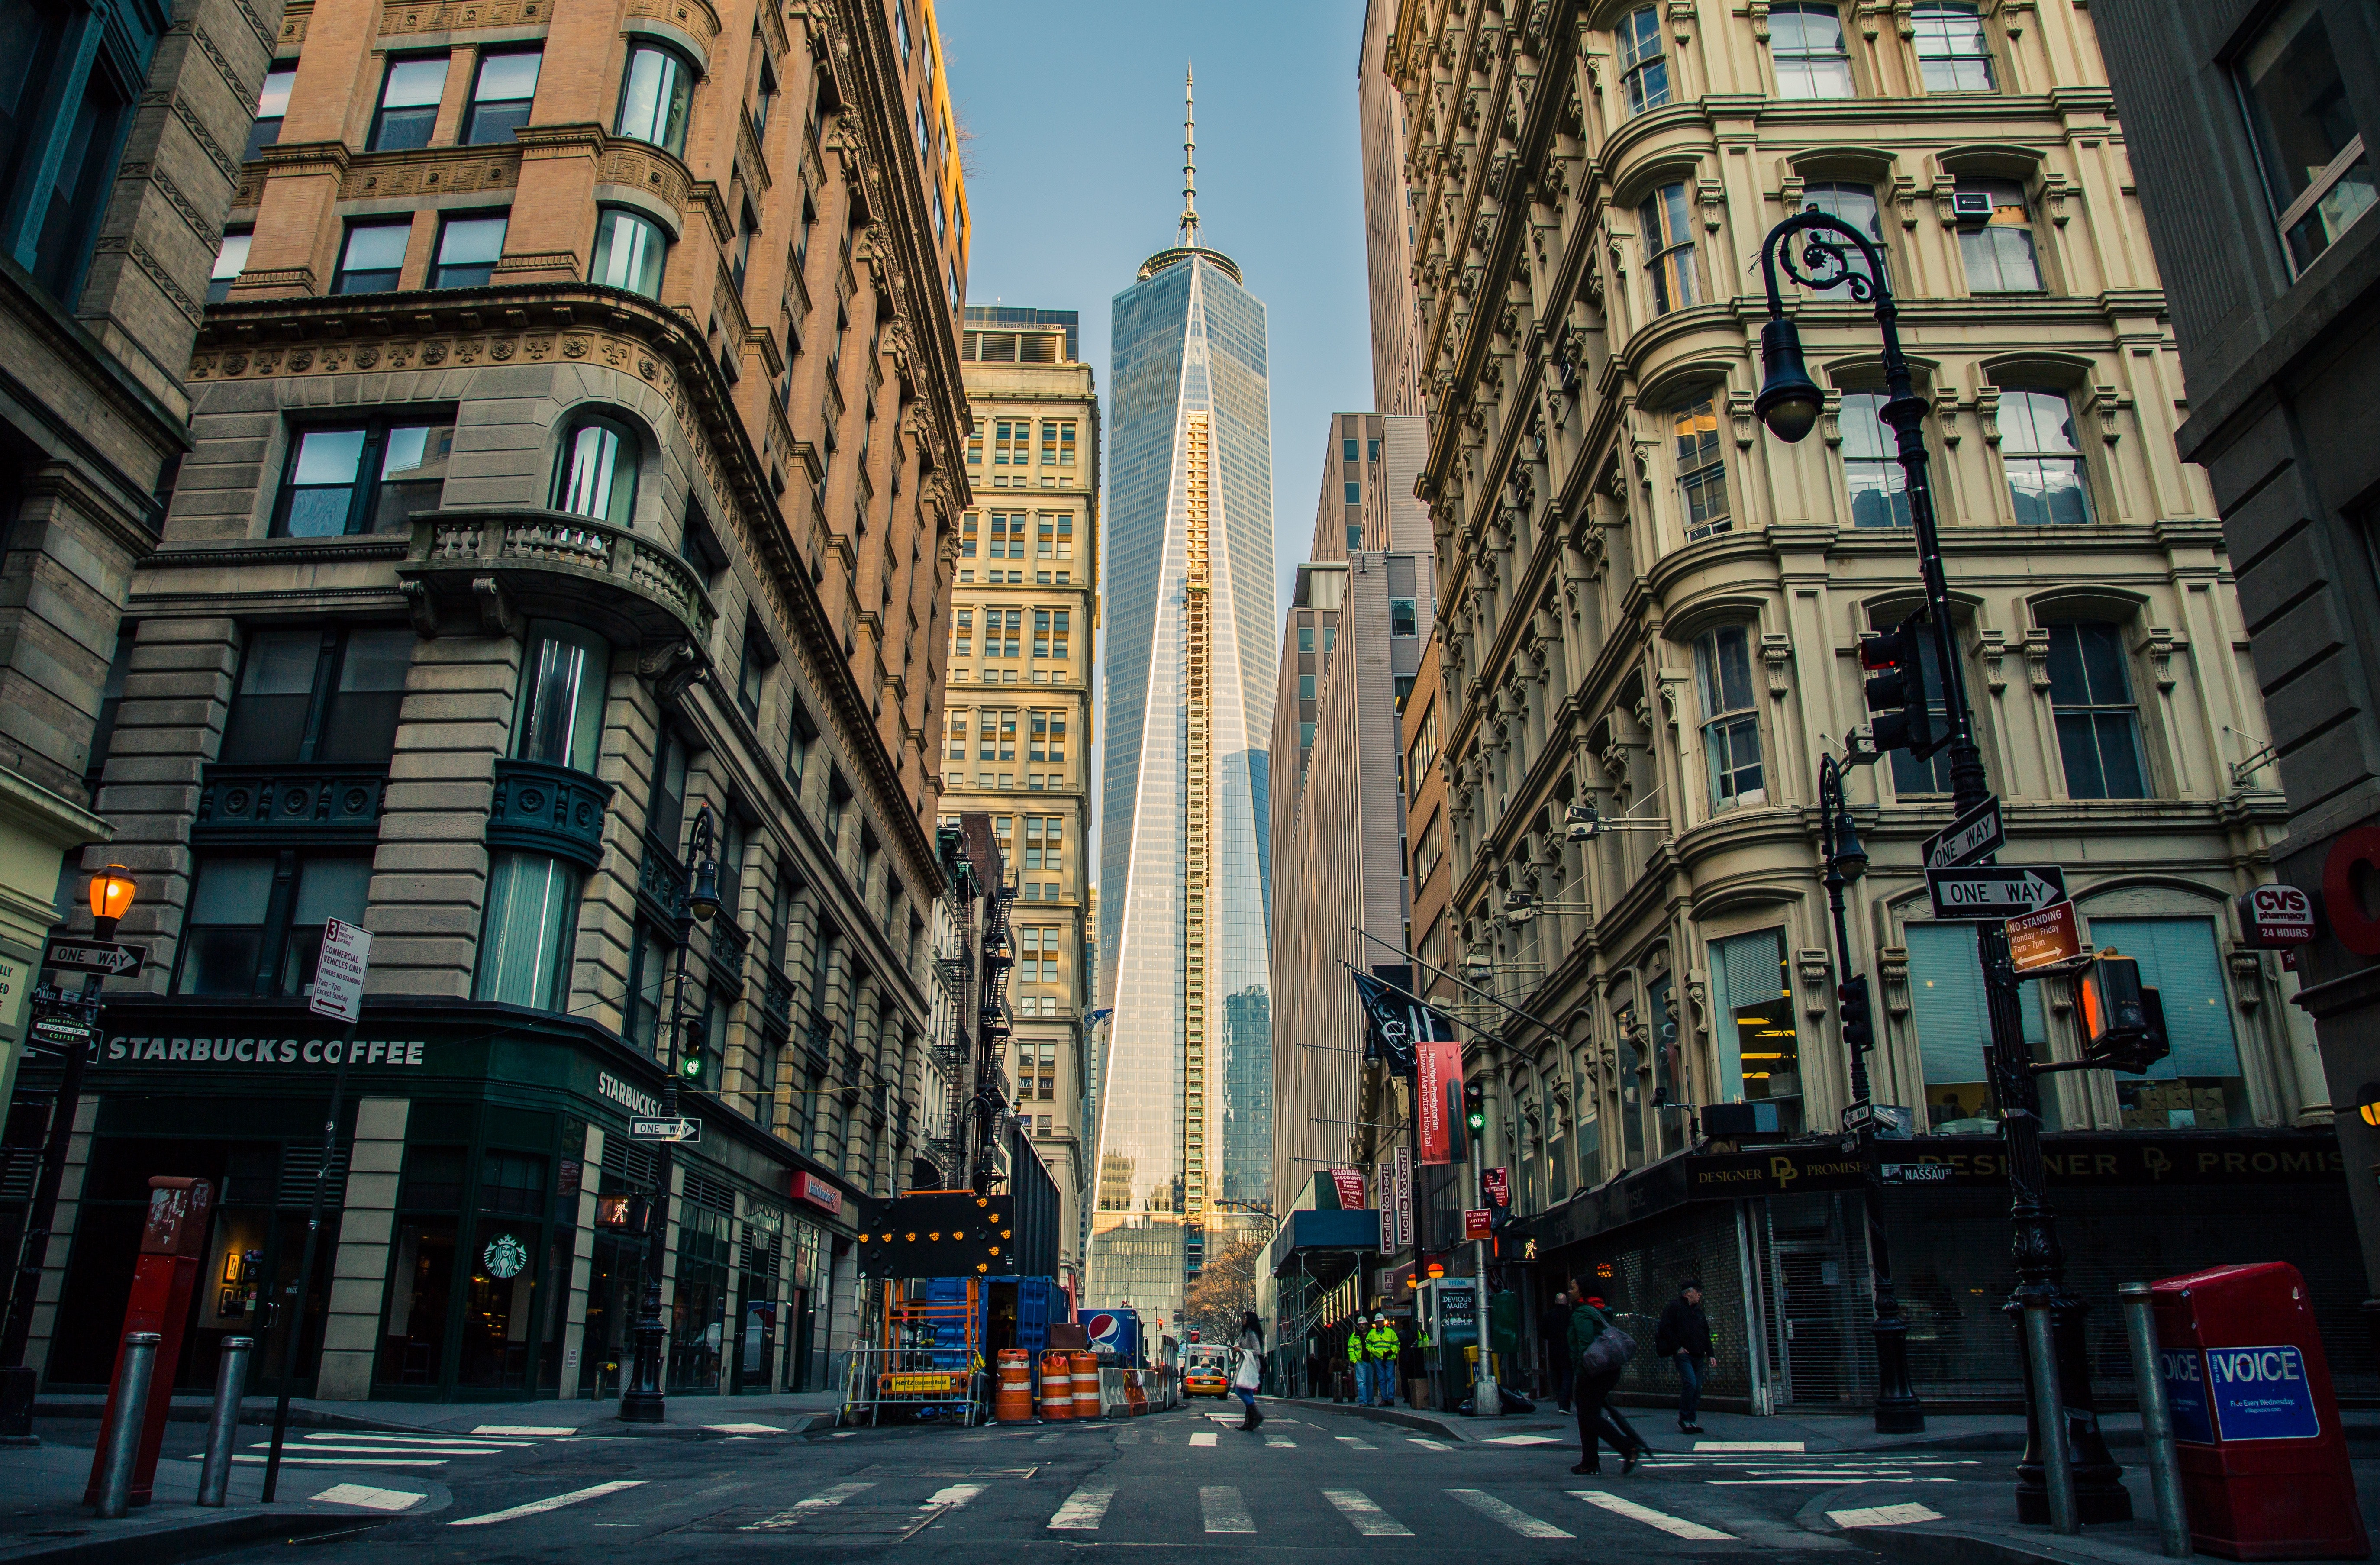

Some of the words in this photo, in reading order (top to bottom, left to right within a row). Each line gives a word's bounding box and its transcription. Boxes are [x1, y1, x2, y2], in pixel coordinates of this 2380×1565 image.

[1935, 840, 1958, 867] ONE
[1966, 817, 1990, 849] WAY
[1950, 884, 1990, 903] ONE
[2004, 882, 2045, 901] WAY
[2255, 891, 2306, 911] CVS
[2009, 922, 2020, 933] NO
[2022, 909, 2062, 929] STANDING
[2258, 911, 2306, 921] pharmacy
[328, 921, 338, 939] 3
[338, 932, 354, 941] metered
[2011, 932, 2035, 944] Monday
[2040, 925, 2059, 936] Friday
[2262, 928, 2274, 937] 24
[2276, 928, 2309, 937] HOURS
[337, 937, 352, 947] parking
[2013, 944, 2027, 953] 7am
[2031, 939, 2045, 949] 7pm
[58, 948, 87, 962] ONE
[98, 952, 129, 966] WAY
[325, 945, 359, 964] COMMERCIAL
[2286, 952, 2294, 963] 24
[324, 955, 348, 970] VEHICLES
[349, 964, 362, 974] ONLY
[319, 978, 328, 987] 7am
[332, 982, 341, 991] 7pm
[320, 967, 336, 978] OTHERS
[342, 974, 361, 986] STANDING
[316, 987, 332, 998] Except
[332, 991, 348, 1004] Sunday
[41, 1024, 85, 1035] FINANCIER
[63, 1019, 84, 1028] ROASTED
[49, 1033, 75, 1041] COFFEE
[108, 1036, 297, 1062] STARBUCKS
[302, 1040, 425, 1065] COFFEE
[598, 1071, 656, 1117] STARBUCKS
[1421, 1075, 1429, 1116] Manhattan
[1845, 1113, 1854, 1124] ONE
[1856, 1107, 1867, 1119] WAY
[640, 1124, 660, 1133] ONE
[669, 1125, 690, 1134] WAY
[1422, 1116, 1433, 1147] Hospital
[1919, 1154, 2119, 1176] ESINER
[2196, 1151, 2345, 1172] PROMIS
[1399, 1148, 1408, 1199] Roberts
[1699, 1168, 1763, 1183] DESIGNER
[1905, 1169, 1945, 1180] NASSAU
[1381, 1164, 1390, 1212] Roberts
[2216, 1351, 2300, 1382] VOICE
[2259, 1398, 2295, 1406] Wednesday.
